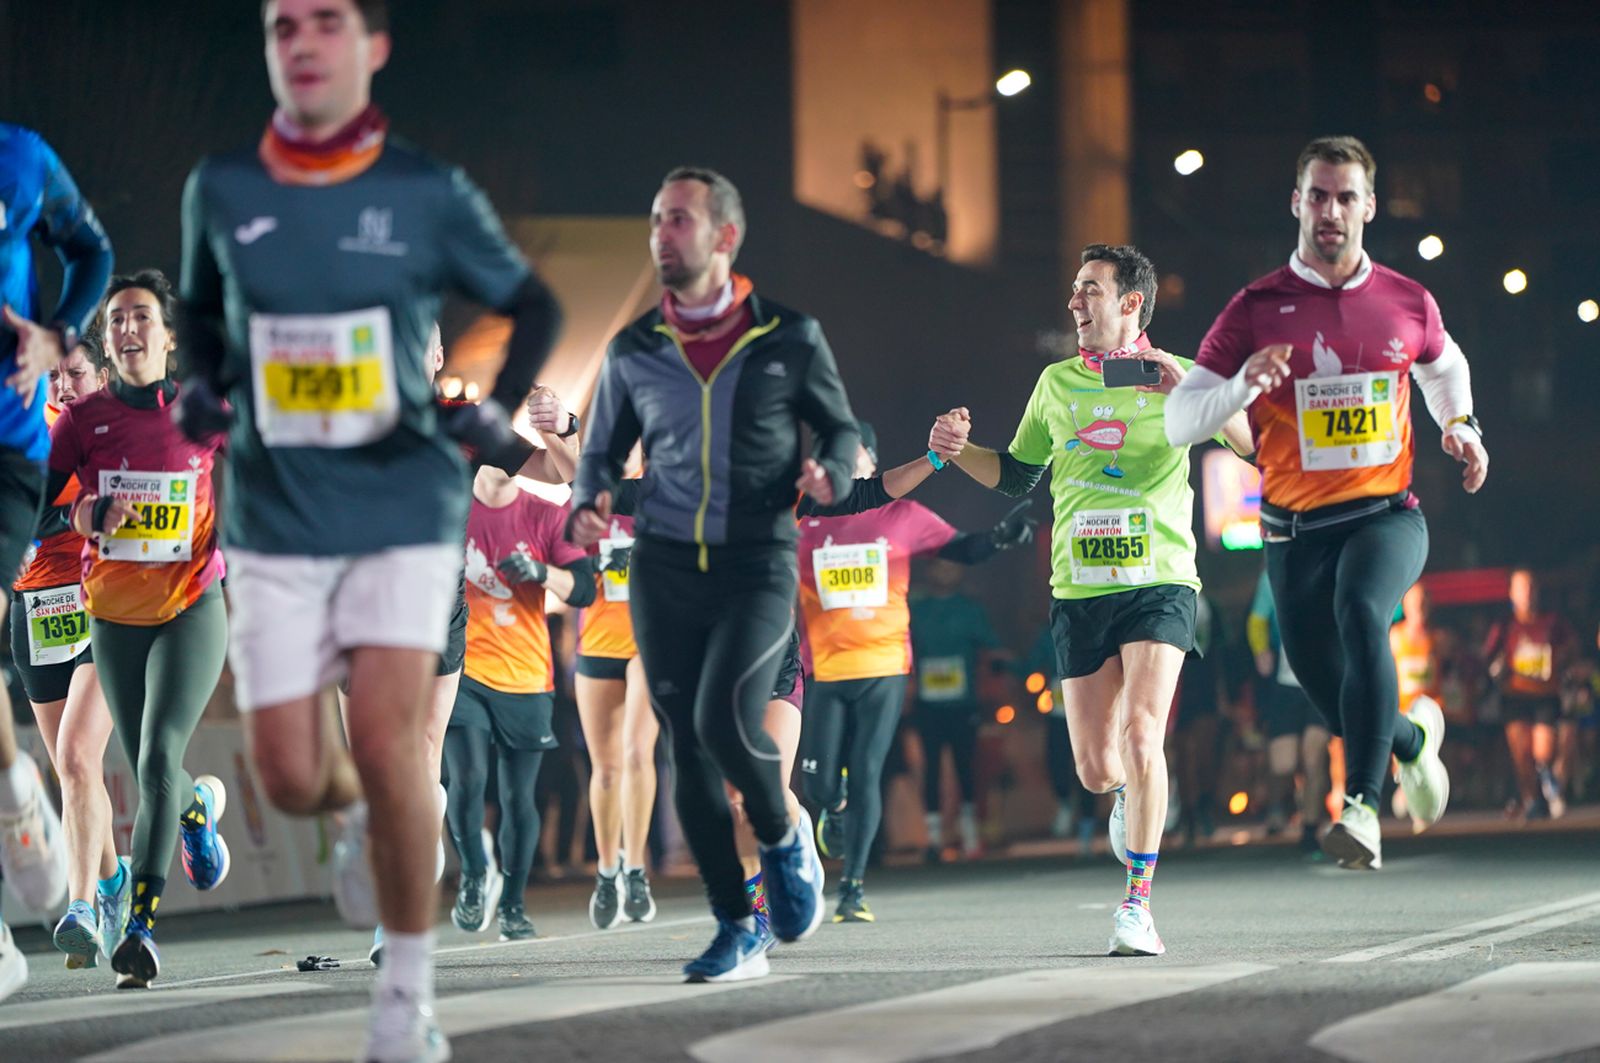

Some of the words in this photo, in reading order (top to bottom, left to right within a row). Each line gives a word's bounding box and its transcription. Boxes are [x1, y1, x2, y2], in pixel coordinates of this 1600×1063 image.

[1320, 387, 1350, 397] NOCHE
[1352, 385, 1363, 395] DE
[1309, 399, 1329, 410] SAN
[1322, 406, 1377, 437] 7421
[120, 482, 147, 491] NOCHE
[150, 482, 161, 491] DE
[1086, 518, 1109, 526] NOCHE
[1111, 518, 1120, 526] DE
[1078, 528, 1093, 537] SAN
[1078, 536, 1144, 559] 12855
[828, 567, 874, 586] 3008
[40, 596, 64, 606] NOCHE
[65, 593, 75, 603] DE
[35, 607, 50, 617] SAN
